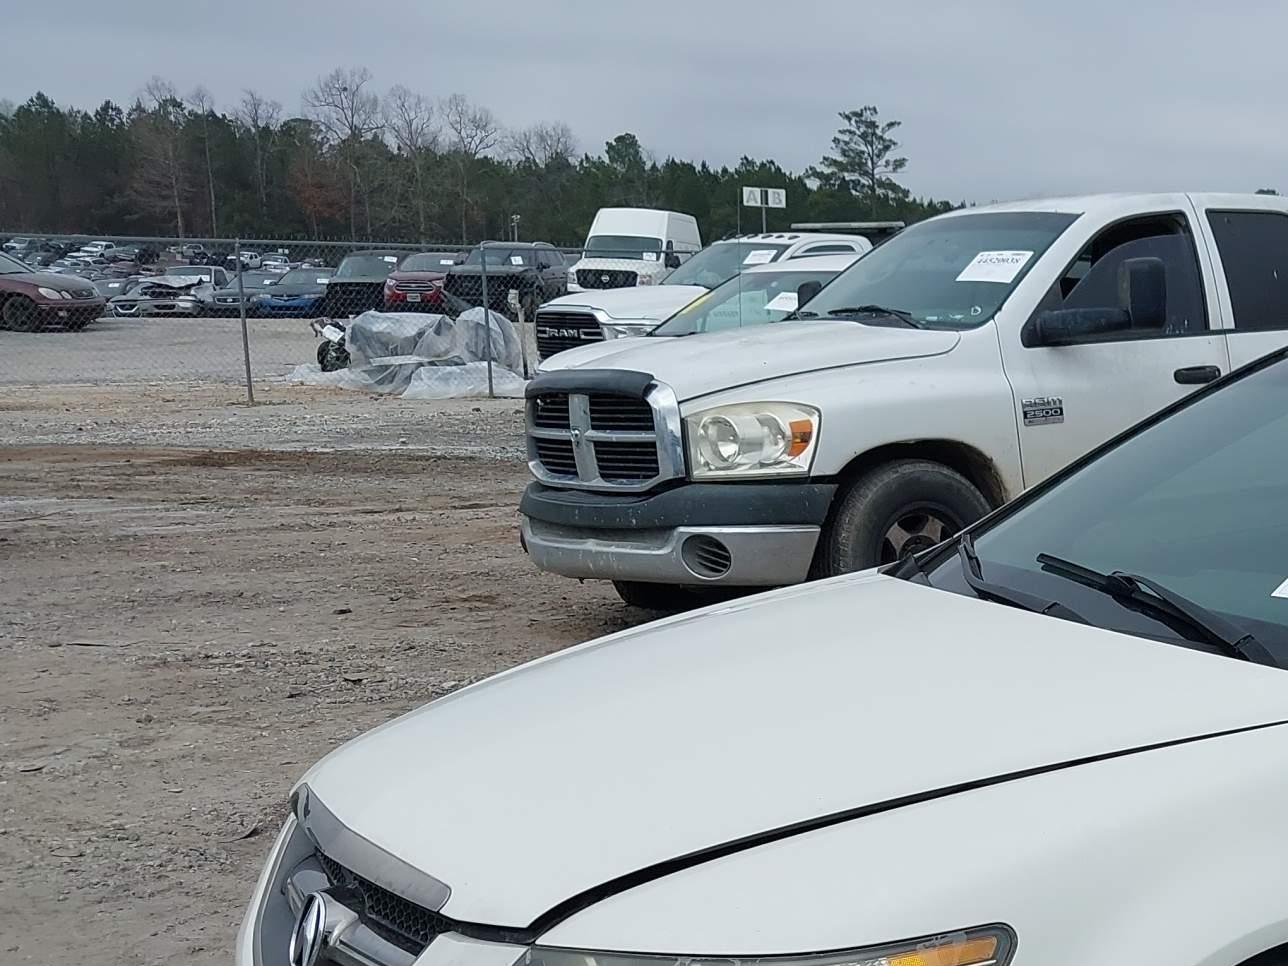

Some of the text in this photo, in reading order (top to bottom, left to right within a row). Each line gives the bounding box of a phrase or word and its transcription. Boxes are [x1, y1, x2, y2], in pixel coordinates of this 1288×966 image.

[745, 190, 759, 204] A
[772, 190, 782, 205] B
[549, 328, 578, 337] RAM
[1026, 408, 1061, 418] 2500
